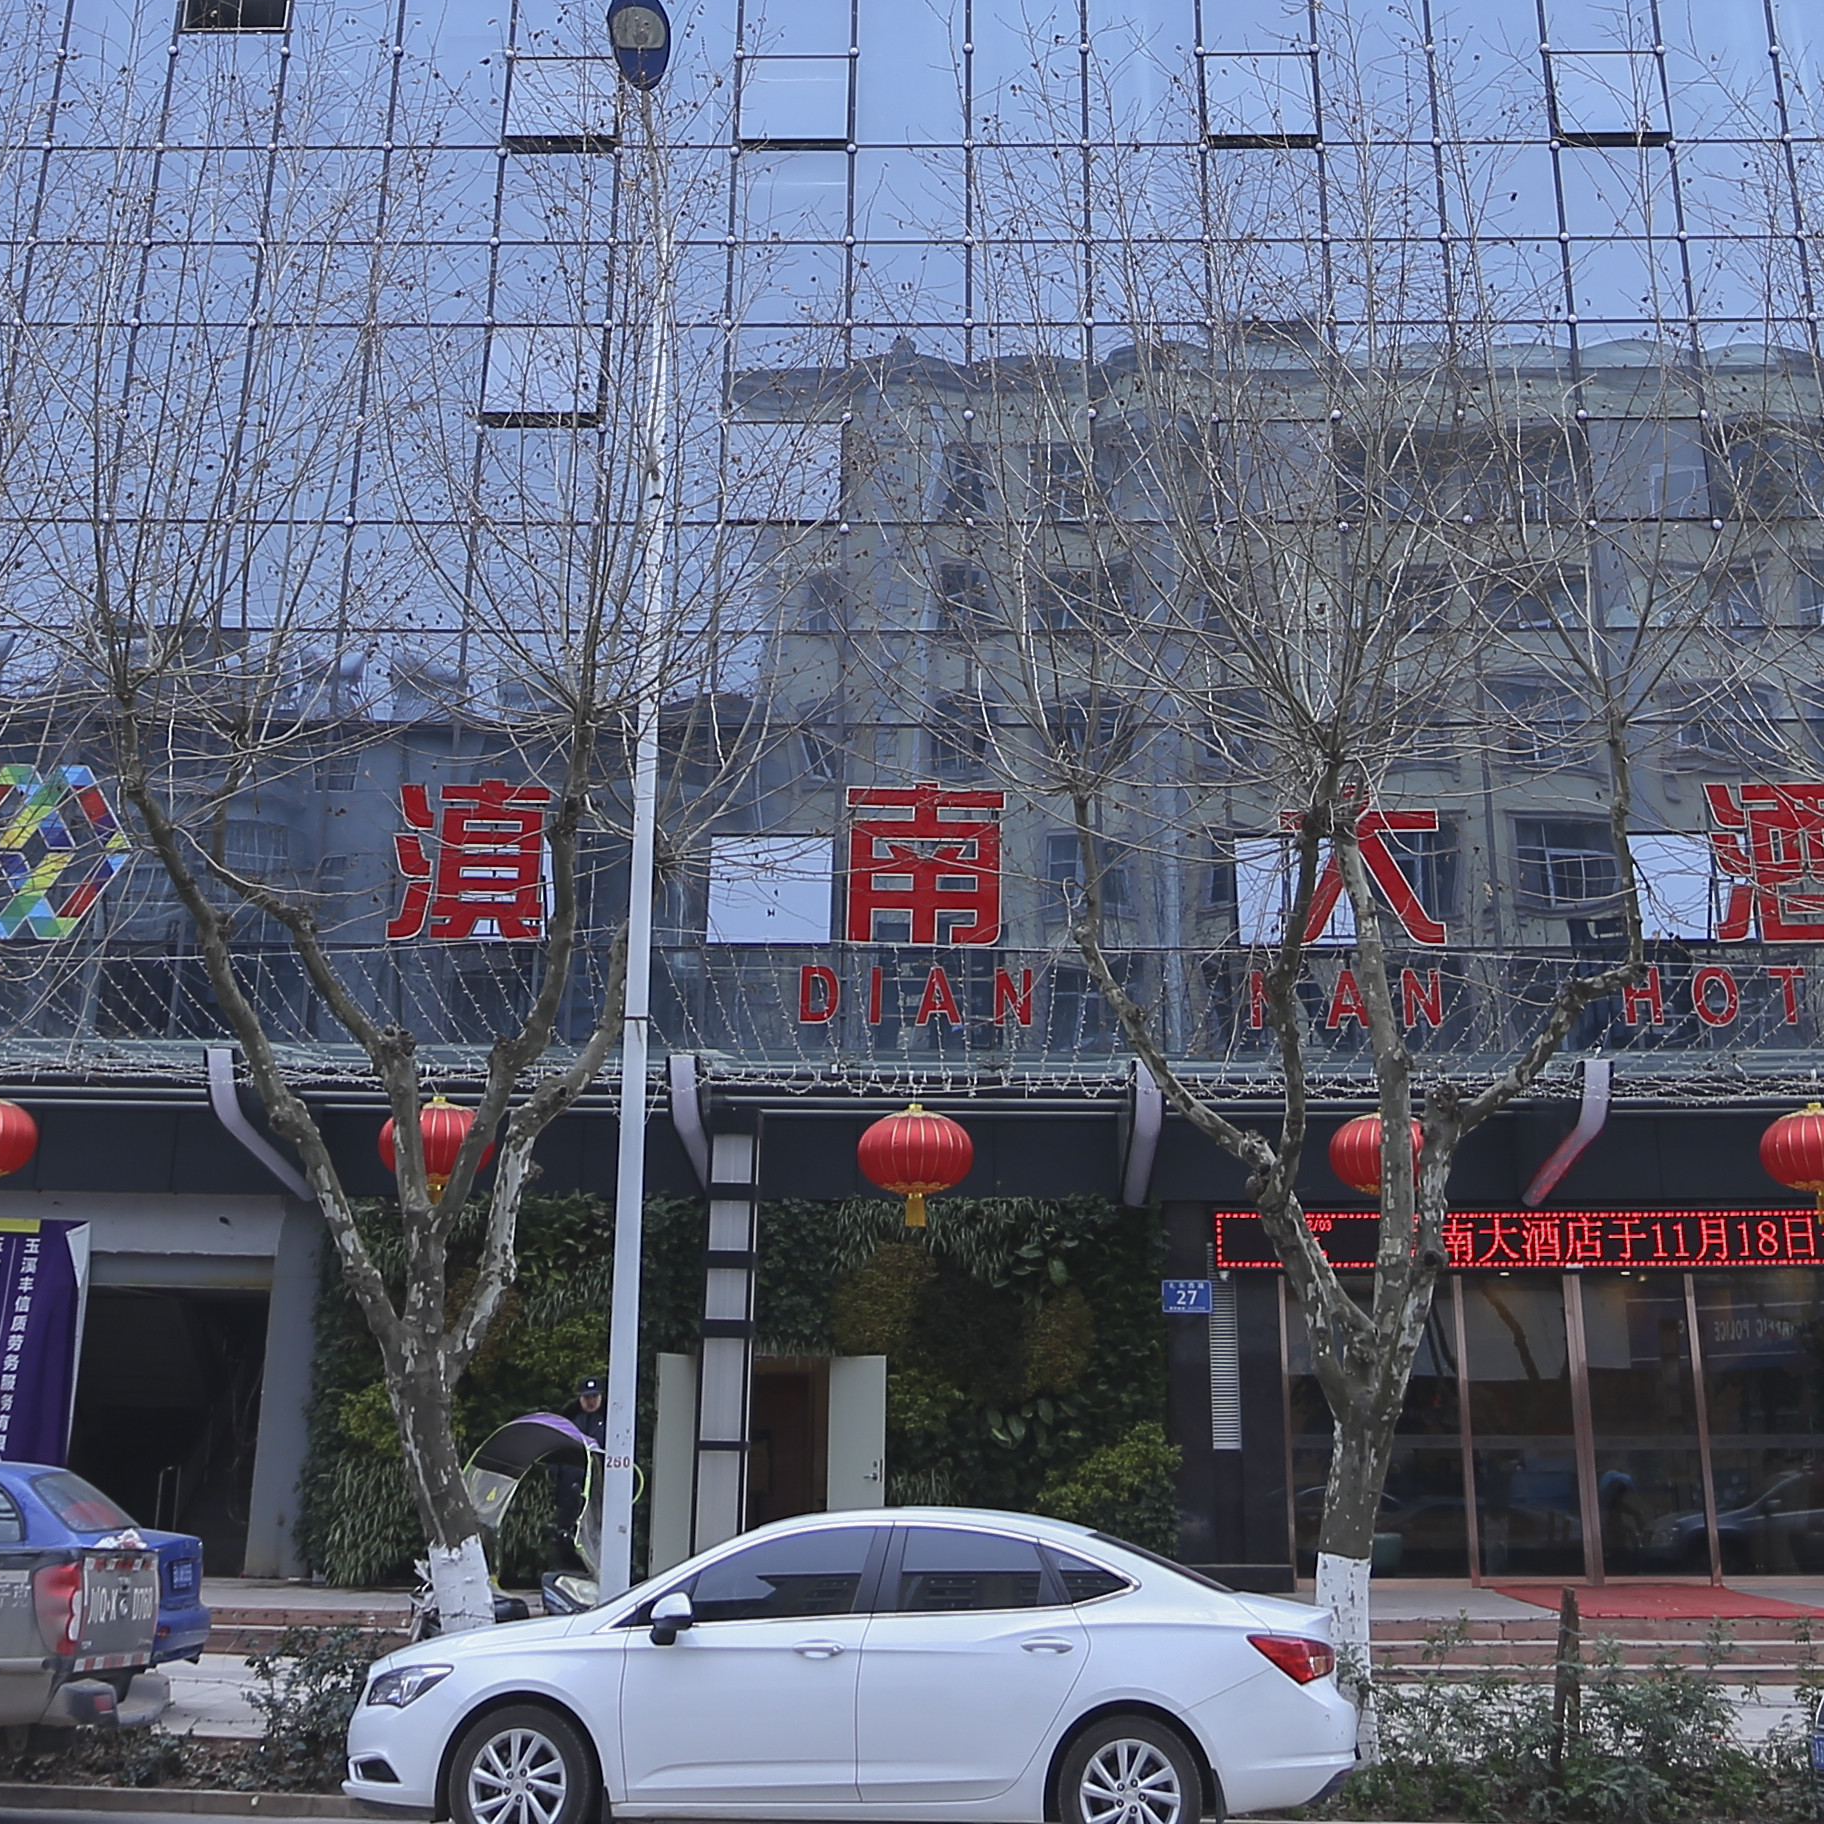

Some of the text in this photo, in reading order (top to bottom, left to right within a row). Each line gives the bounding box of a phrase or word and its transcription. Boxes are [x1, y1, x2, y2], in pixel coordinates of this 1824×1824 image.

[798, 965, 1033, 1027] DIAN
[1176, 1290, 1197, 1305] 27
[606, 1455, 630, 1469] 260
